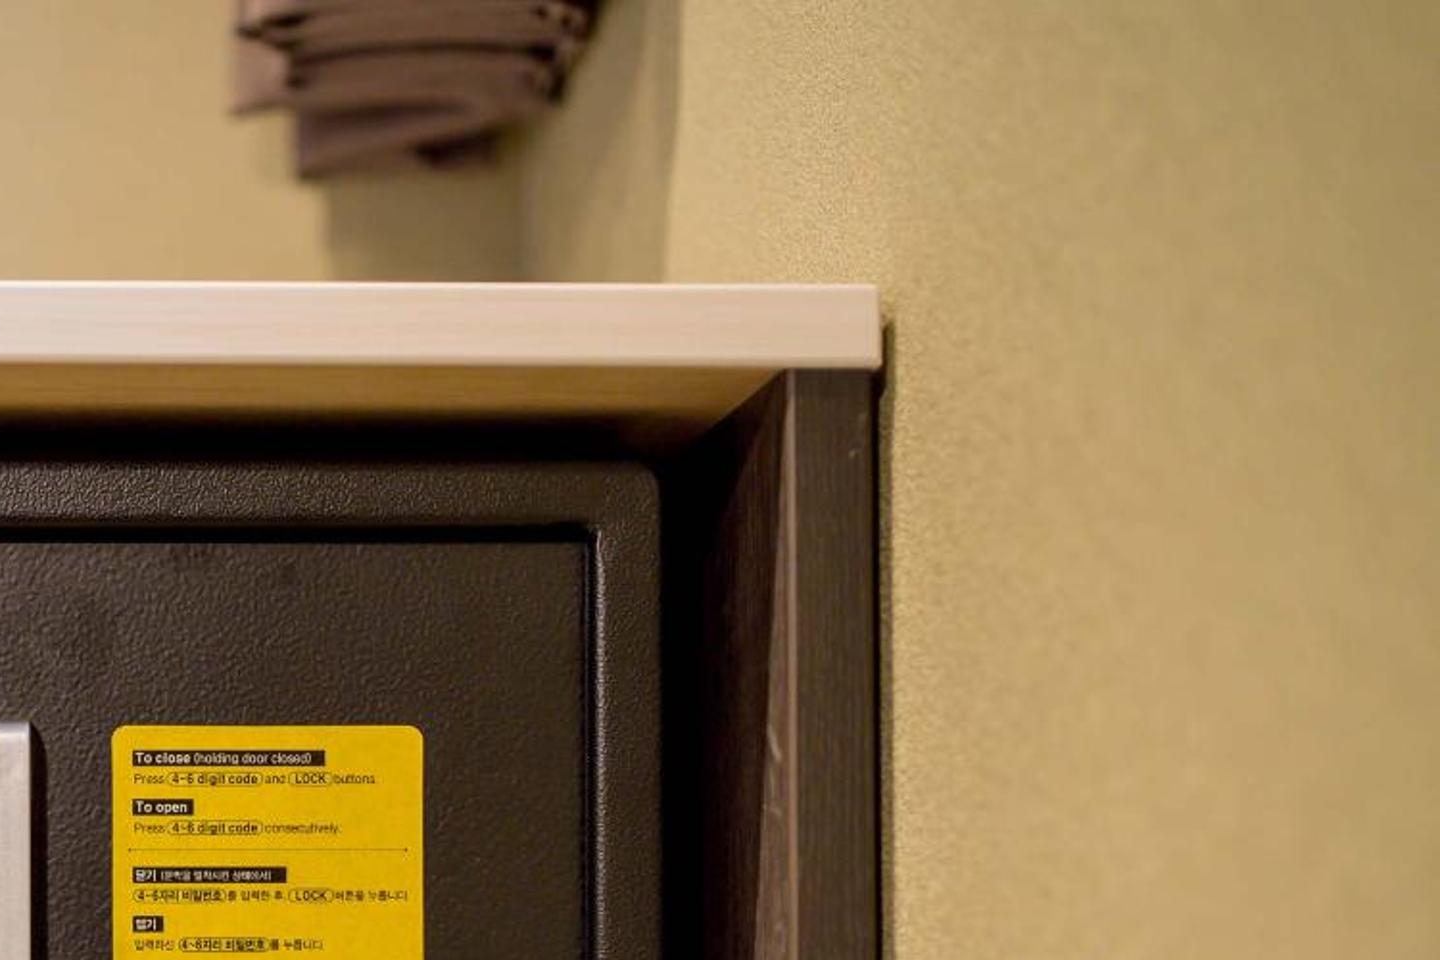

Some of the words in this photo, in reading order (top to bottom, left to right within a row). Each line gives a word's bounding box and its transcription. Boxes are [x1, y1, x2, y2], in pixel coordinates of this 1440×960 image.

[135, 752, 153, 765] To
[155, 752, 191, 765] close
[241, 752, 268, 765] door
[134, 773, 164, 786] Press
[197, 773, 225, 786] digit
[228, 773, 258, 786] code
[265, 773, 285, 786] and
[295, 773, 327, 786] LOCK
[135, 801, 153, 814] To
[155, 801, 188, 814] open
[134, 822, 164, 835] Press
[197, 822, 225, 835] digit
[228, 822, 258, 835] code
[295, 890, 327, 902] LOCK
